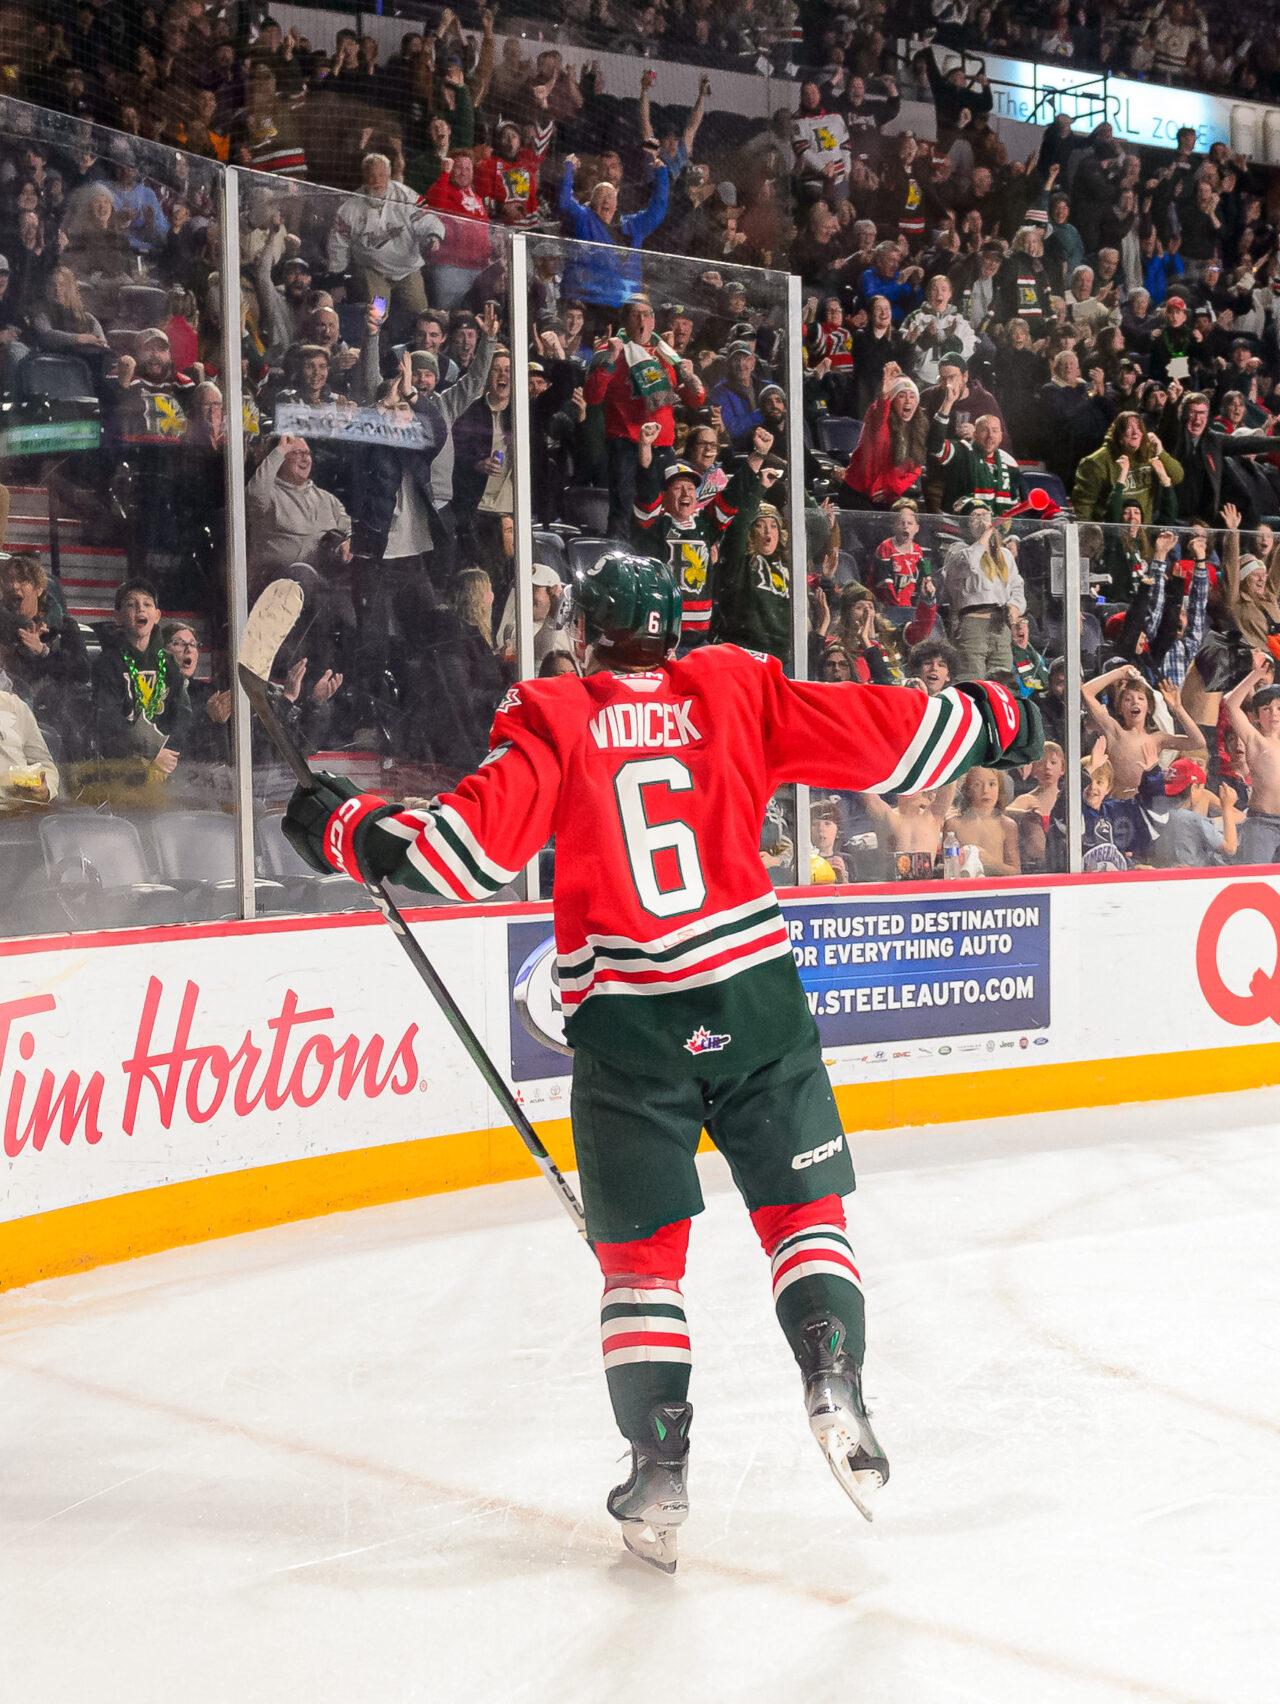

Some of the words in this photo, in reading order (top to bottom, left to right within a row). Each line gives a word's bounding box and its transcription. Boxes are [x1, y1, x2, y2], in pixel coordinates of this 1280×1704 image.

[995, 90, 1028, 120] The
[1153, 116, 1209, 146] ZOE
[647, 611, 661, 634] 6
[589, 699, 703, 749] VIDICEK
[613, 755, 708, 920] 6
[810, 914, 905, 939] TRUSTED
[911, 907, 1039, 934] DESTINATION
[793, 946, 818, 968] OR
[825, 941, 954, 966] EVERYTHING
[960, 934, 1013, 956] AUTO
[999, 1040, 1015, 1048] Jeep
[0, 993, 105, 1158] Tim
[122, 975, 420, 1137] Hortons
[791, 1135, 843, 1171] CCM
